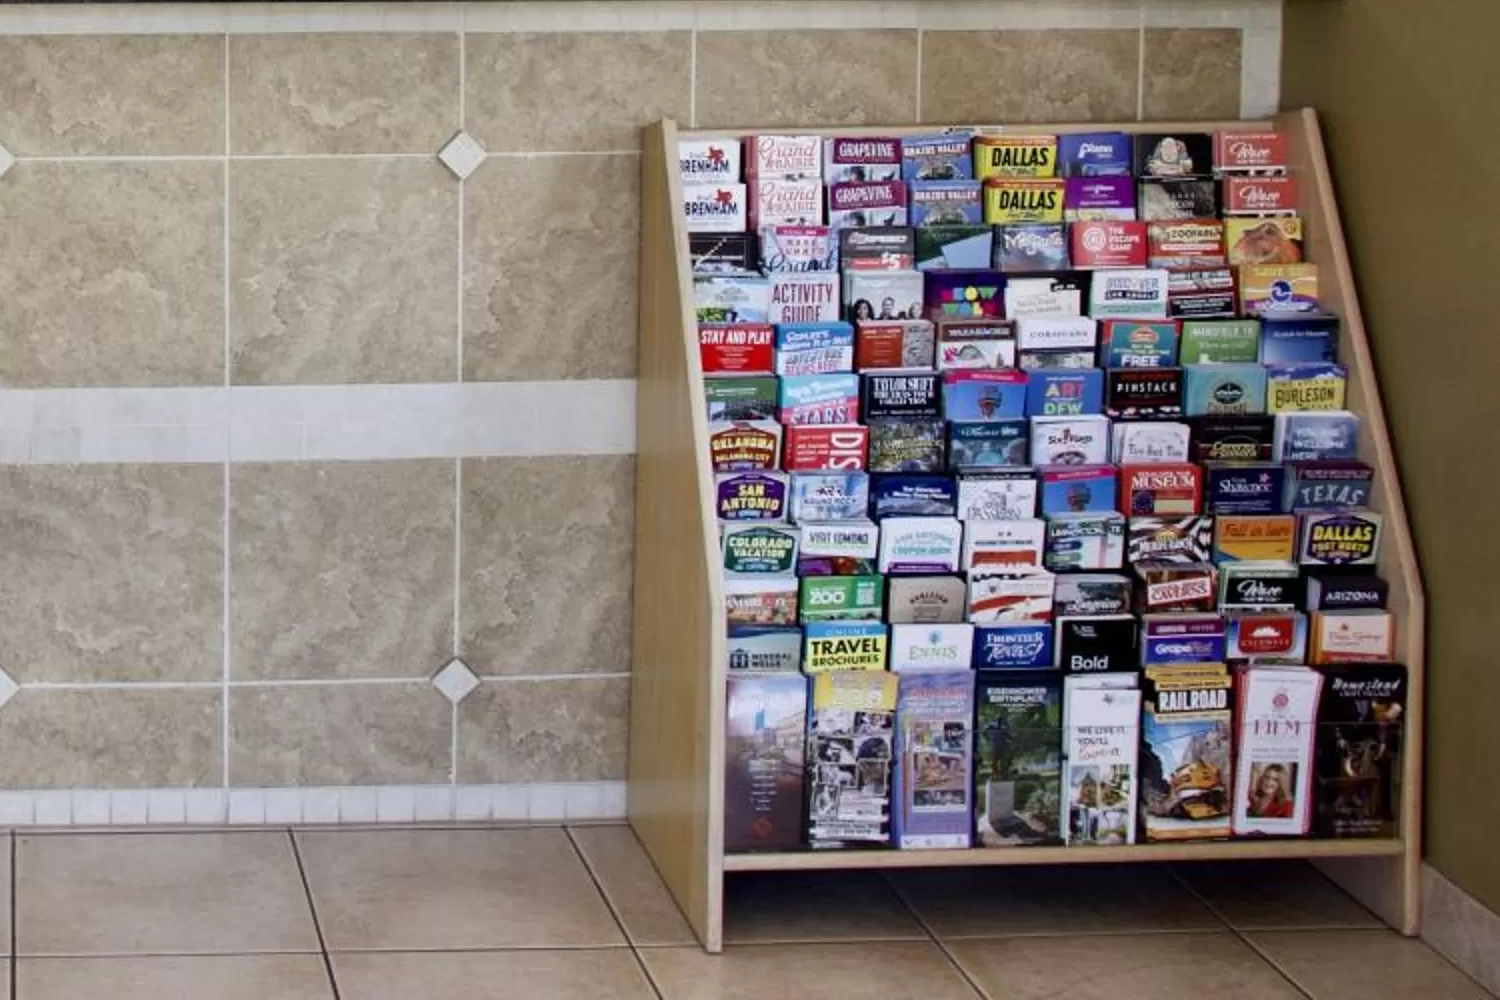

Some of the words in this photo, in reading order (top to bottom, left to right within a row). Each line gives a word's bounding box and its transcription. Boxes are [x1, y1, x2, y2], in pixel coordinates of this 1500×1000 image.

[838, 141, 895, 158] GRAPEVINE
[991, 147, 1049, 168] DALLAS
[835, 184, 893, 204] GRAPEVINE
[999, 190, 1057, 210] DALLAS
[685, 201, 738, 216] BRENHAM
[1107, 235, 1140, 243] ESCAPE
[772, 283, 833, 304] ACTIVITY
[781, 305, 821, 323] GUIDE
[701, 331, 724, 345] STAY
[726, 331, 746, 345] AND
[747, 331, 771, 345] PLAY
[1121, 354, 1161, 367] FREE
[873, 377, 907, 391] TAYLOR
[908, 377, 935, 391] SWIFT
[1045, 383, 1085, 397] ART
[1117, 382, 1177, 393] PINSTACK
[1275, 388, 1335, 409] BURLESON
[1045, 401, 1084, 416] DFW
[712, 437, 774, 450] OKLAHOMA
[1131, 475, 1195, 490] MUSEUM
[738, 484, 765, 497] SAN
[1301, 483, 1365, 505] TEXAS
[721, 498, 780, 512] ANTONIO
[1313, 525, 1373, 541] DALLAS
[728, 536, 793, 551] COLORADO
[733, 548, 787, 560] VACATION
[809, 588, 845, 605] ZOO
[1325, 591, 1379, 601] ARIZONA
[811, 638, 881, 655] TRAVEL
[910, 646, 958, 661] ENNIS
[812, 653, 879, 667] BROCHURES
[1071, 656, 1109, 671] Bold
[987, 687, 1047, 695] EISENHOWER
[1332, 676, 1400, 691] Homestead
[989, 695, 1045, 703] BIRTHPLACE
[1159, 690, 1227, 711] RAILROAD
